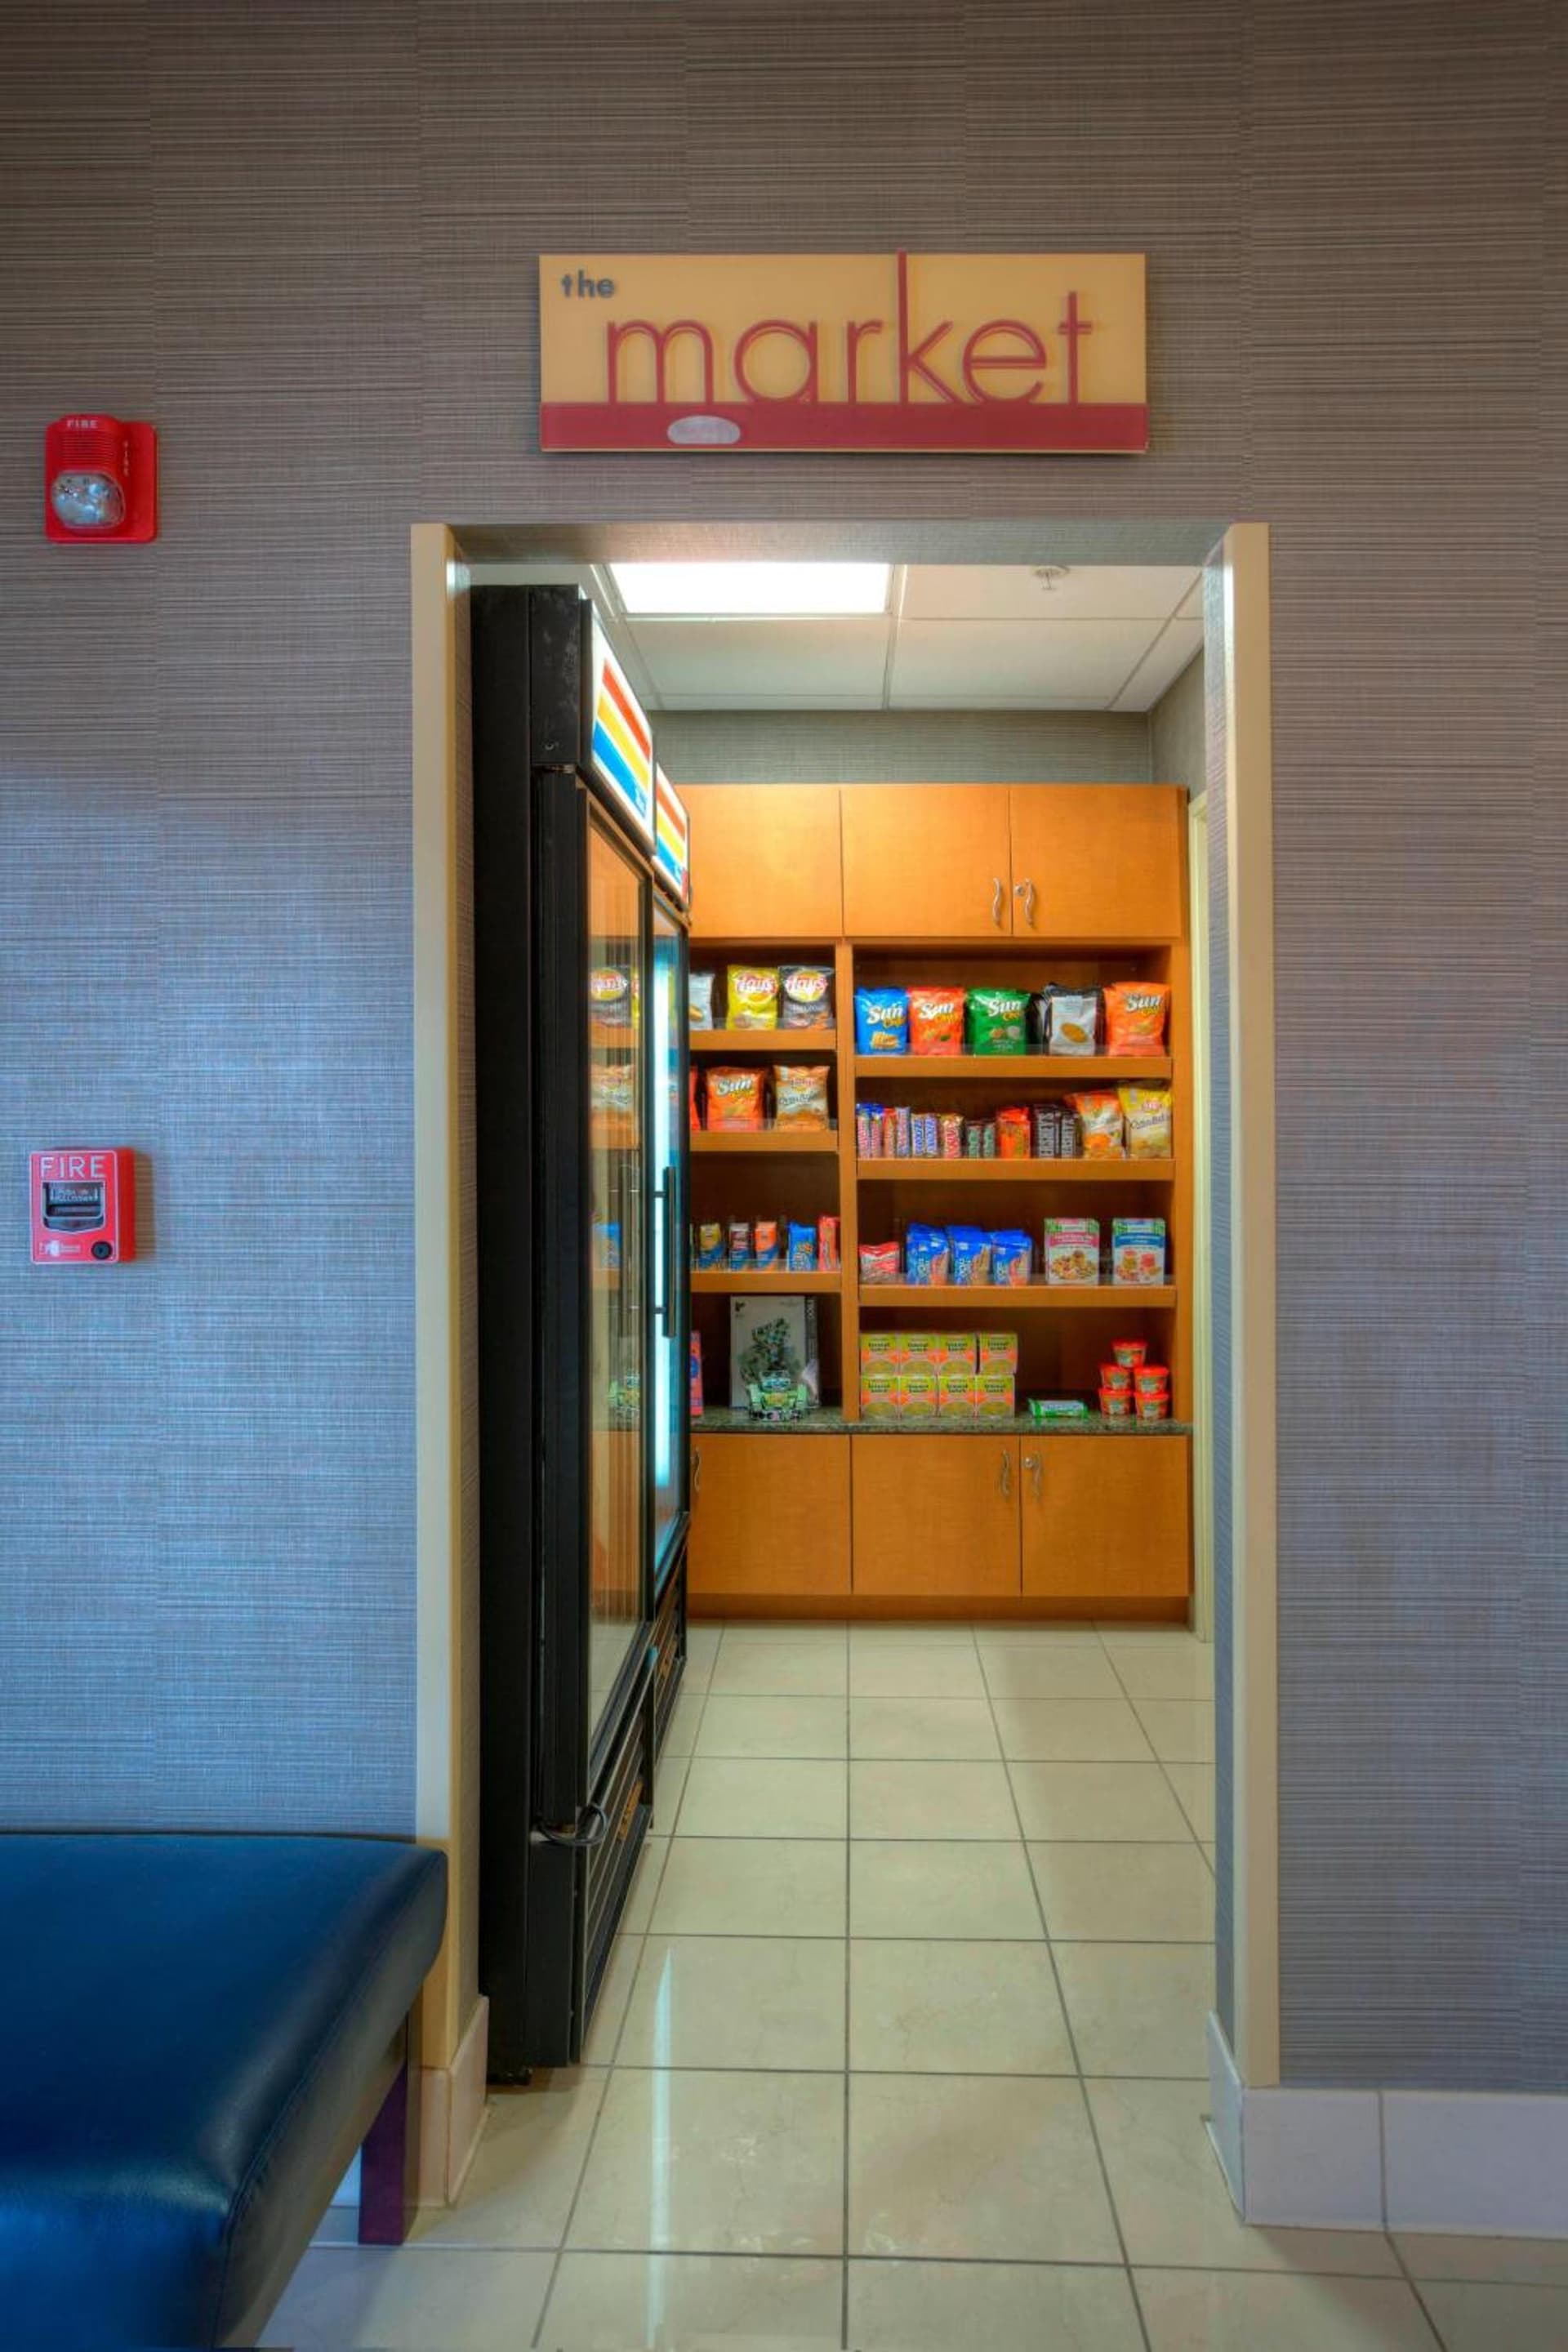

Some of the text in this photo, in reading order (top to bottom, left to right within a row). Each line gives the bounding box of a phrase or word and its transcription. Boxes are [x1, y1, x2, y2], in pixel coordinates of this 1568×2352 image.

[561, 270, 616, 299] the
[607, 252, 1094, 403] market
[66, 419, 99, 429] FIRE
[918, 1001, 955, 1019] Sun
[987, 999, 1022, 1018] Sun
[1125, 993, 1162, 1013] Sun
[866, 1004, 904, 1025] Sun
[716, 1077, 753, 1096] Sun
[40, 1156, 106, 1178] FIRE
